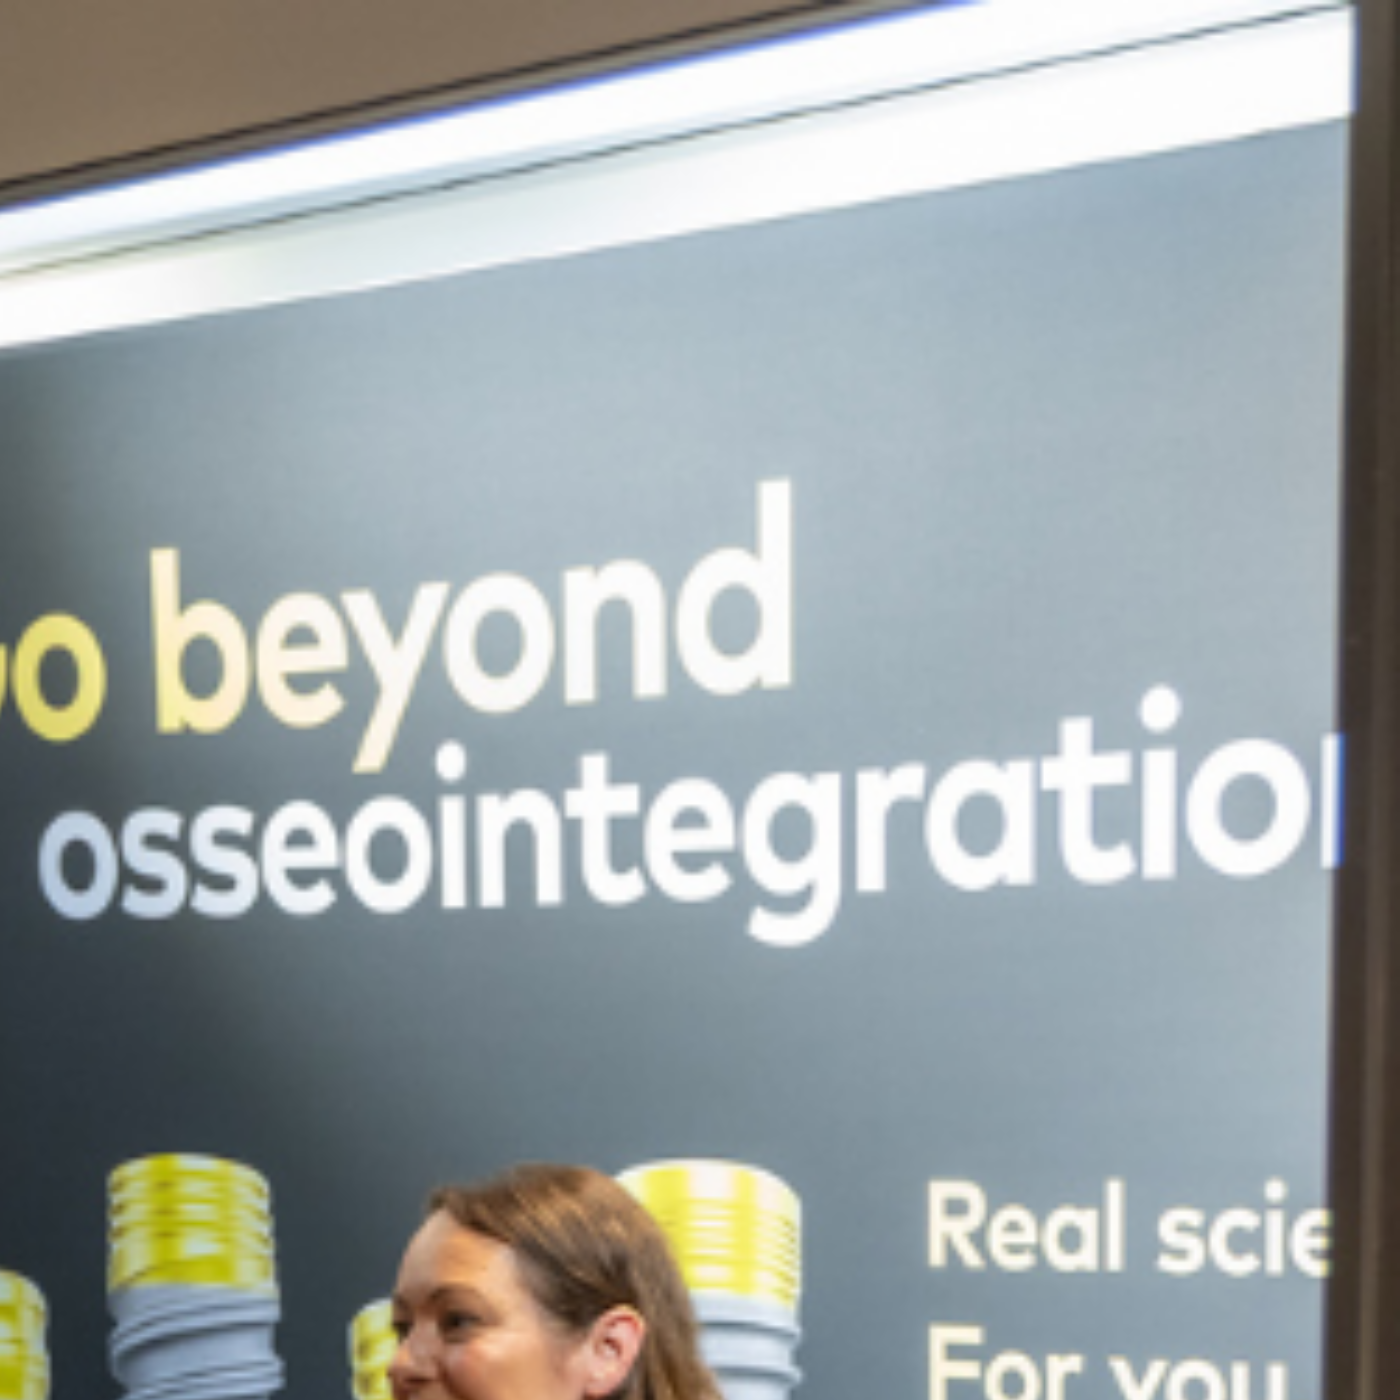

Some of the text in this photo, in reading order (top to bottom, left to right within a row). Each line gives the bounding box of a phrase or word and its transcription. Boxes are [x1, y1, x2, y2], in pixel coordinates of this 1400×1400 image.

[149, 477, 792, 774] beyond
[38, 684, 1345, 948] osseointegratio
[927, 1178, 1126, 1272] Real
